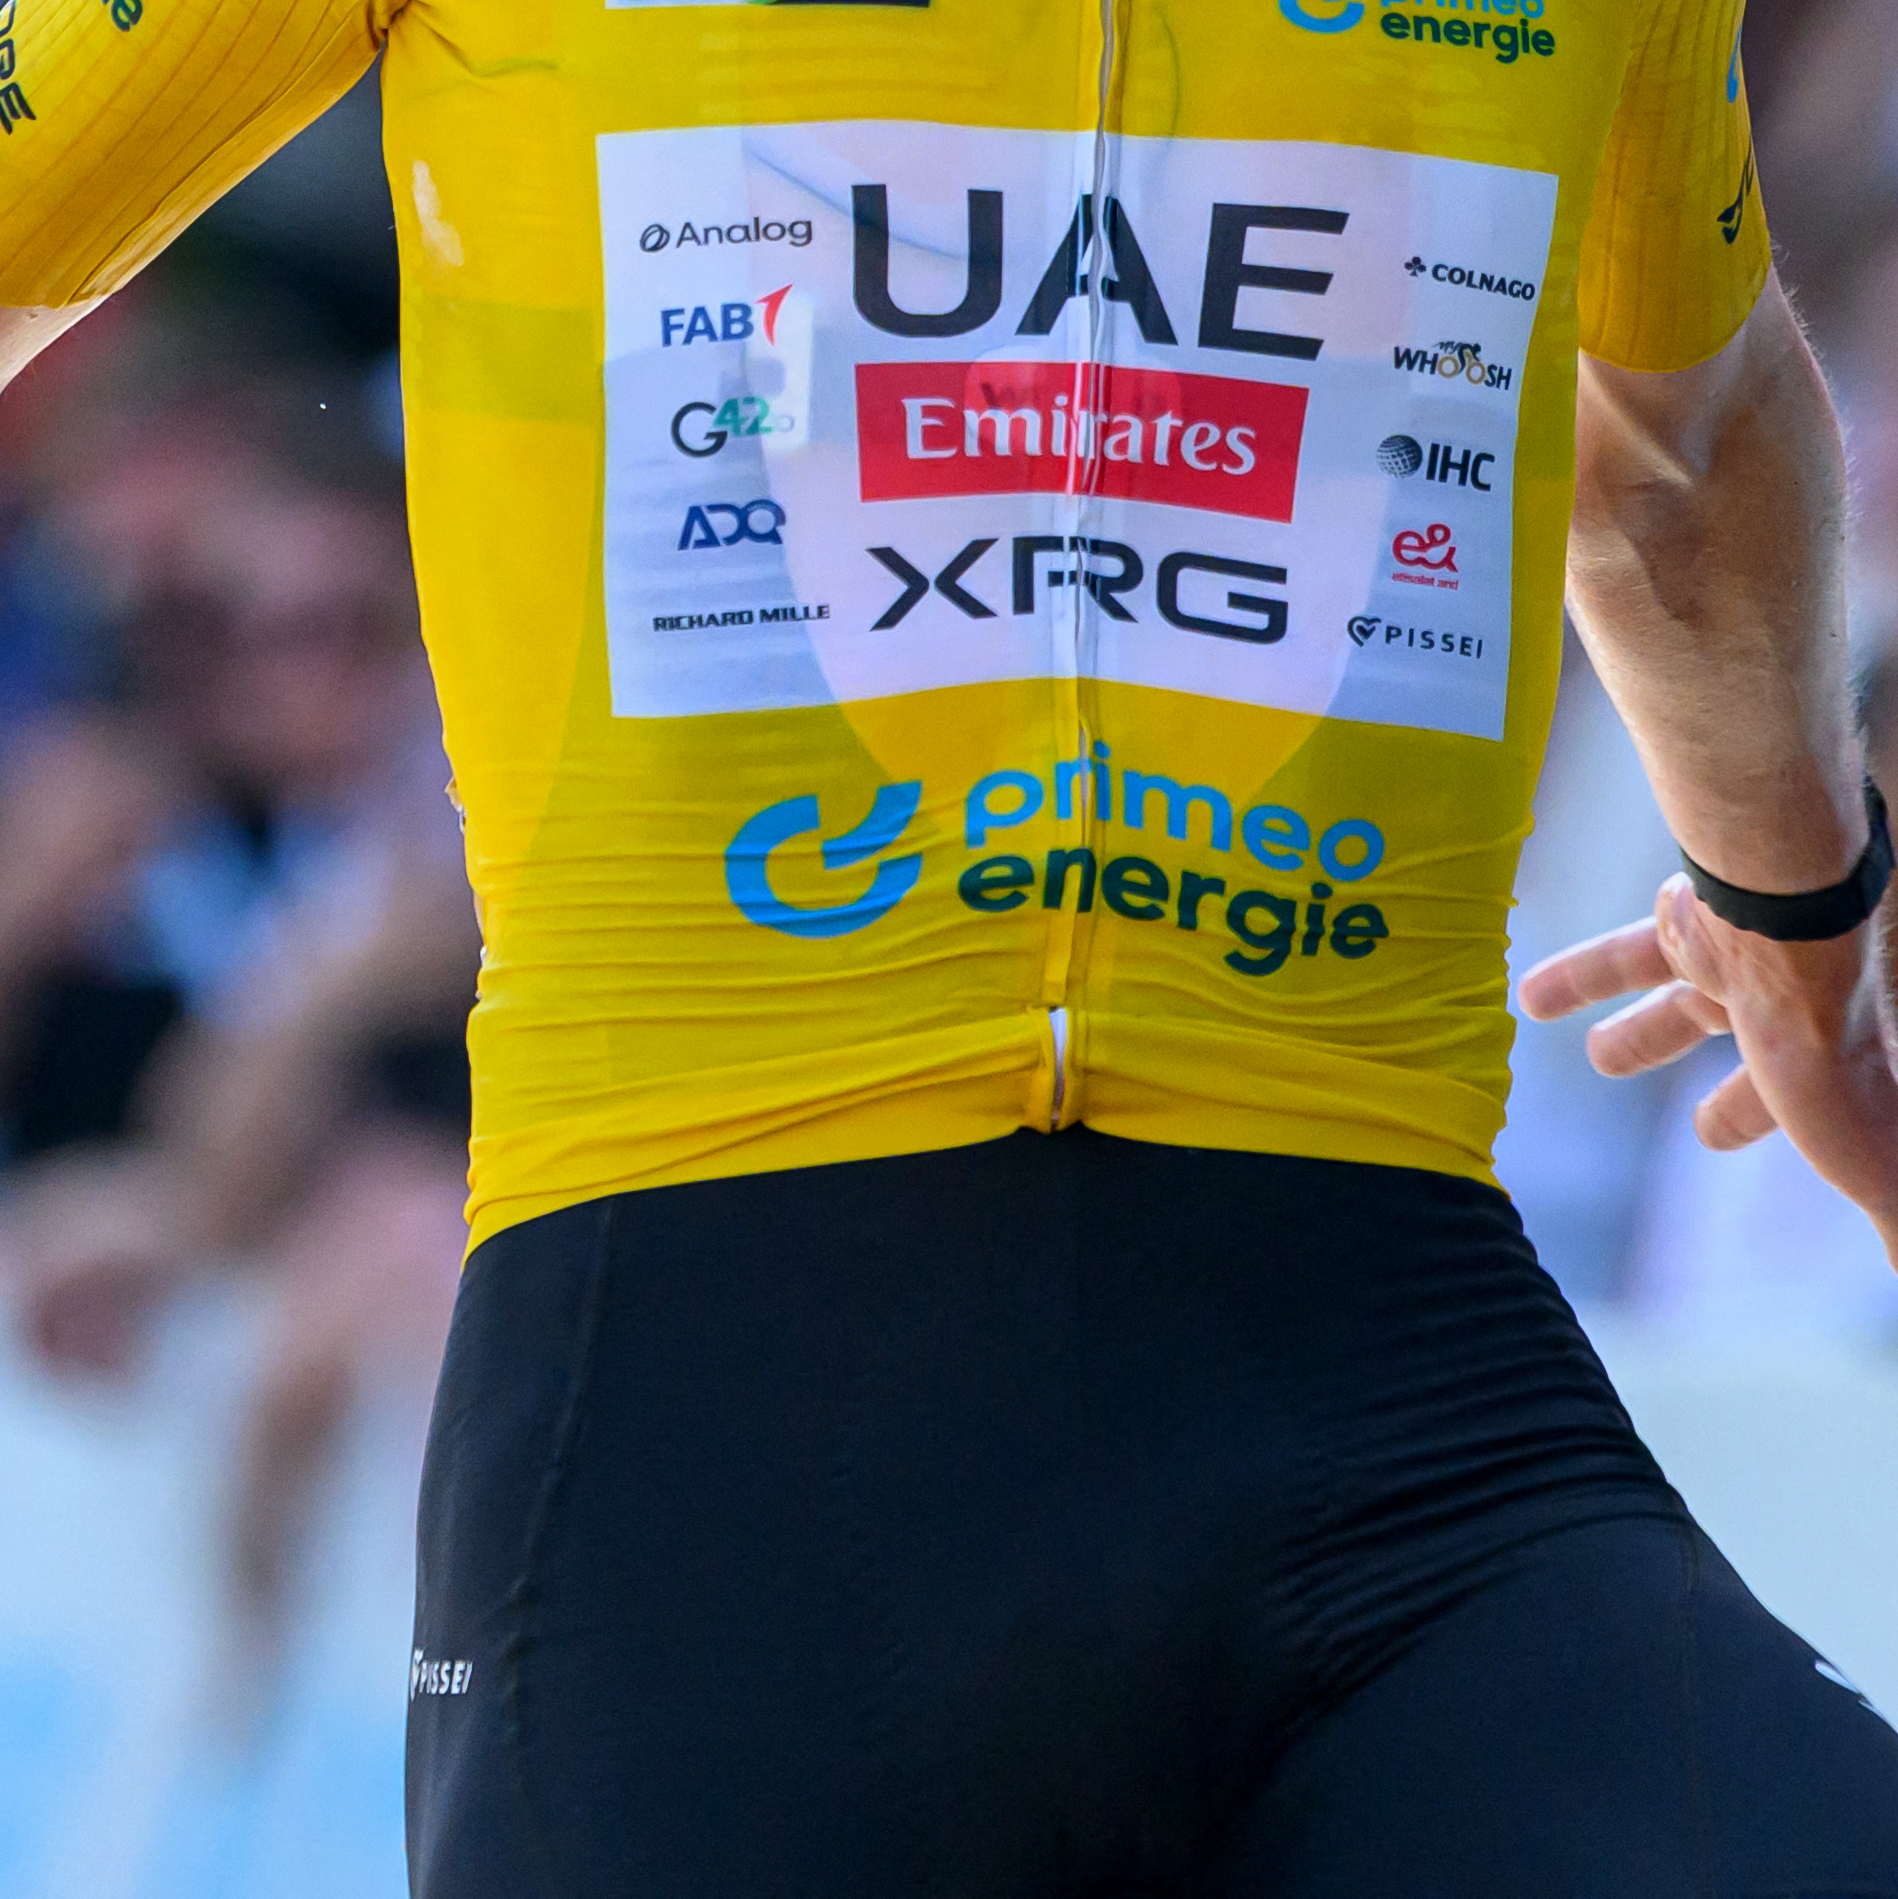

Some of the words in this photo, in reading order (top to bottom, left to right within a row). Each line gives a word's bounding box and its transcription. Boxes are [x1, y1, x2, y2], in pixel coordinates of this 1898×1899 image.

[1380, 12, 1556, 65] energie
[676, 217, 813, 247] Analog
[851, 183, 1350, 362] UAE
[1431, 264, 1536, 302] COLNAGO
[660, 302, 754, 347] FAB
[900, 393, 1256, 476] Emirates
[1425, 442, 1496, 492] IHC
[677, 499, 786, 552] ADQ
[864, 535, 1289, 645] XRG
[652, 609, 755, 633] RICHARD
[759, 604, 831, 624] MILLE
[1384, 625, 1483, 660] PISSEI
[964, 742, 1385, 883] primeo
[957, 845, 1390, 977] energie
[419, 1659, 473, 1695] PISSEI
